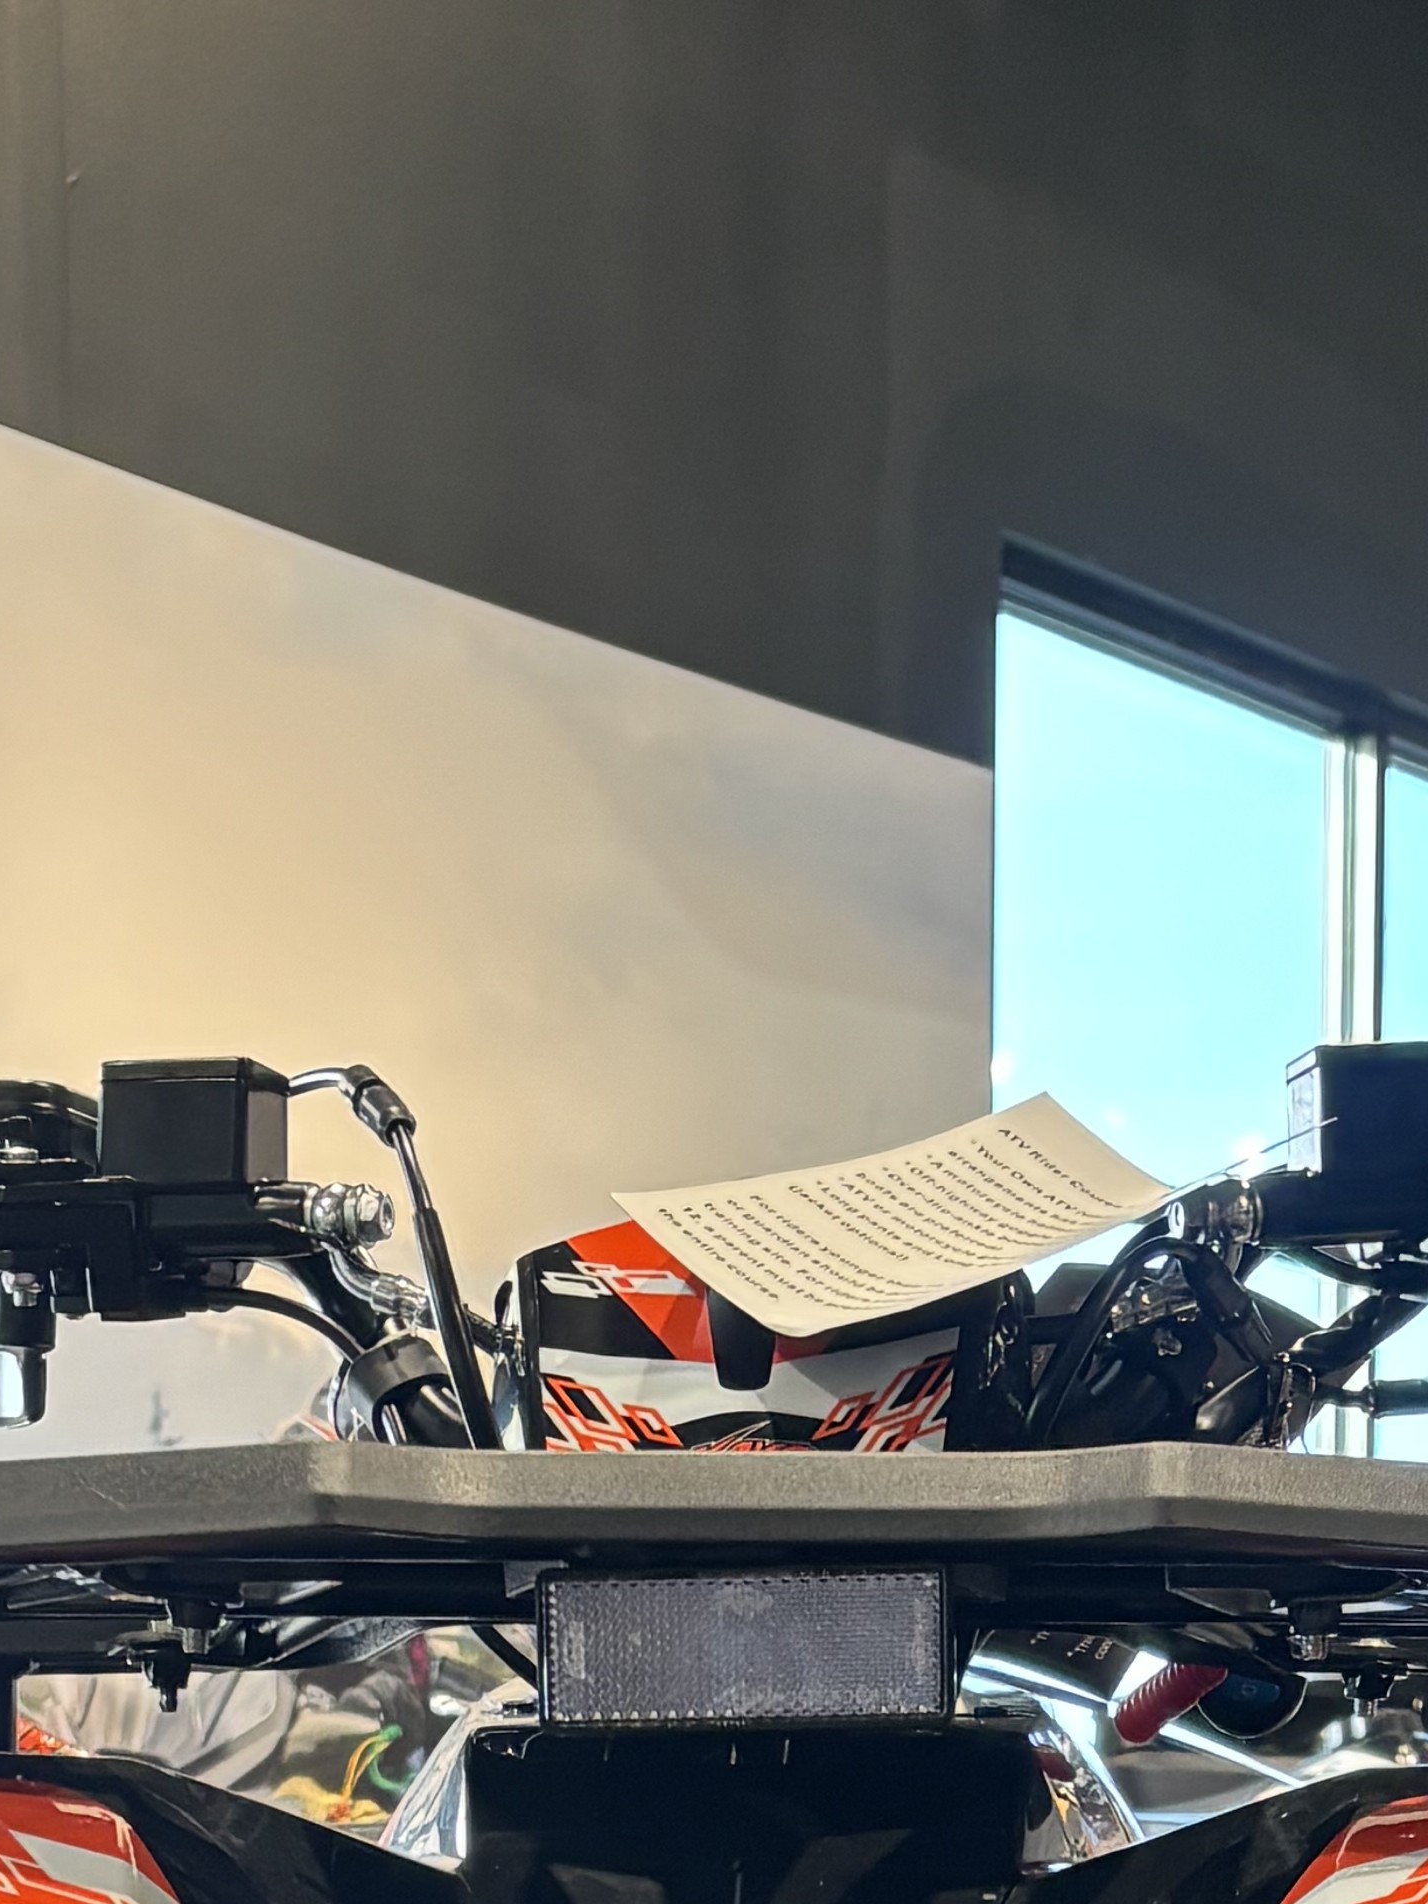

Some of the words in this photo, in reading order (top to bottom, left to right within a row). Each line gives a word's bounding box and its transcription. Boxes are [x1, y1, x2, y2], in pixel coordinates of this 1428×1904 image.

[977, 1145, 1011, 1172] Your
[1010, 1169, 1044, 1195] Own
[997, 1128, 1031, 1150] ATV
[1029, 1150, 1070, 1180] Rider
[821, 1185, 860, 1216] Long
[857, 1213, 903, 1242] pants
[902, 1240, 930, 1257] and
[840, 1182, 876, 1203] ATV
[874, 1202, 892, 1215] or
[898, 1200, 925, 1218] are
[657, 1207, 683, 1228] the
[681, 1228, 726, 1263] entire
[703, 1202, 762, 1247] training
[795, 1267, 826, 1287] For
[726, 1199, 746, 1213] or
[743, 1211, 811, 1260] guardian
[748, 1194, 778, 1214] For
[774, 1212, 821, 1246] riders
[819, 1244, 885, 1282] younger
[712, 1233, 765, 1268] parent
[763, 1268, 806, 1296] must
